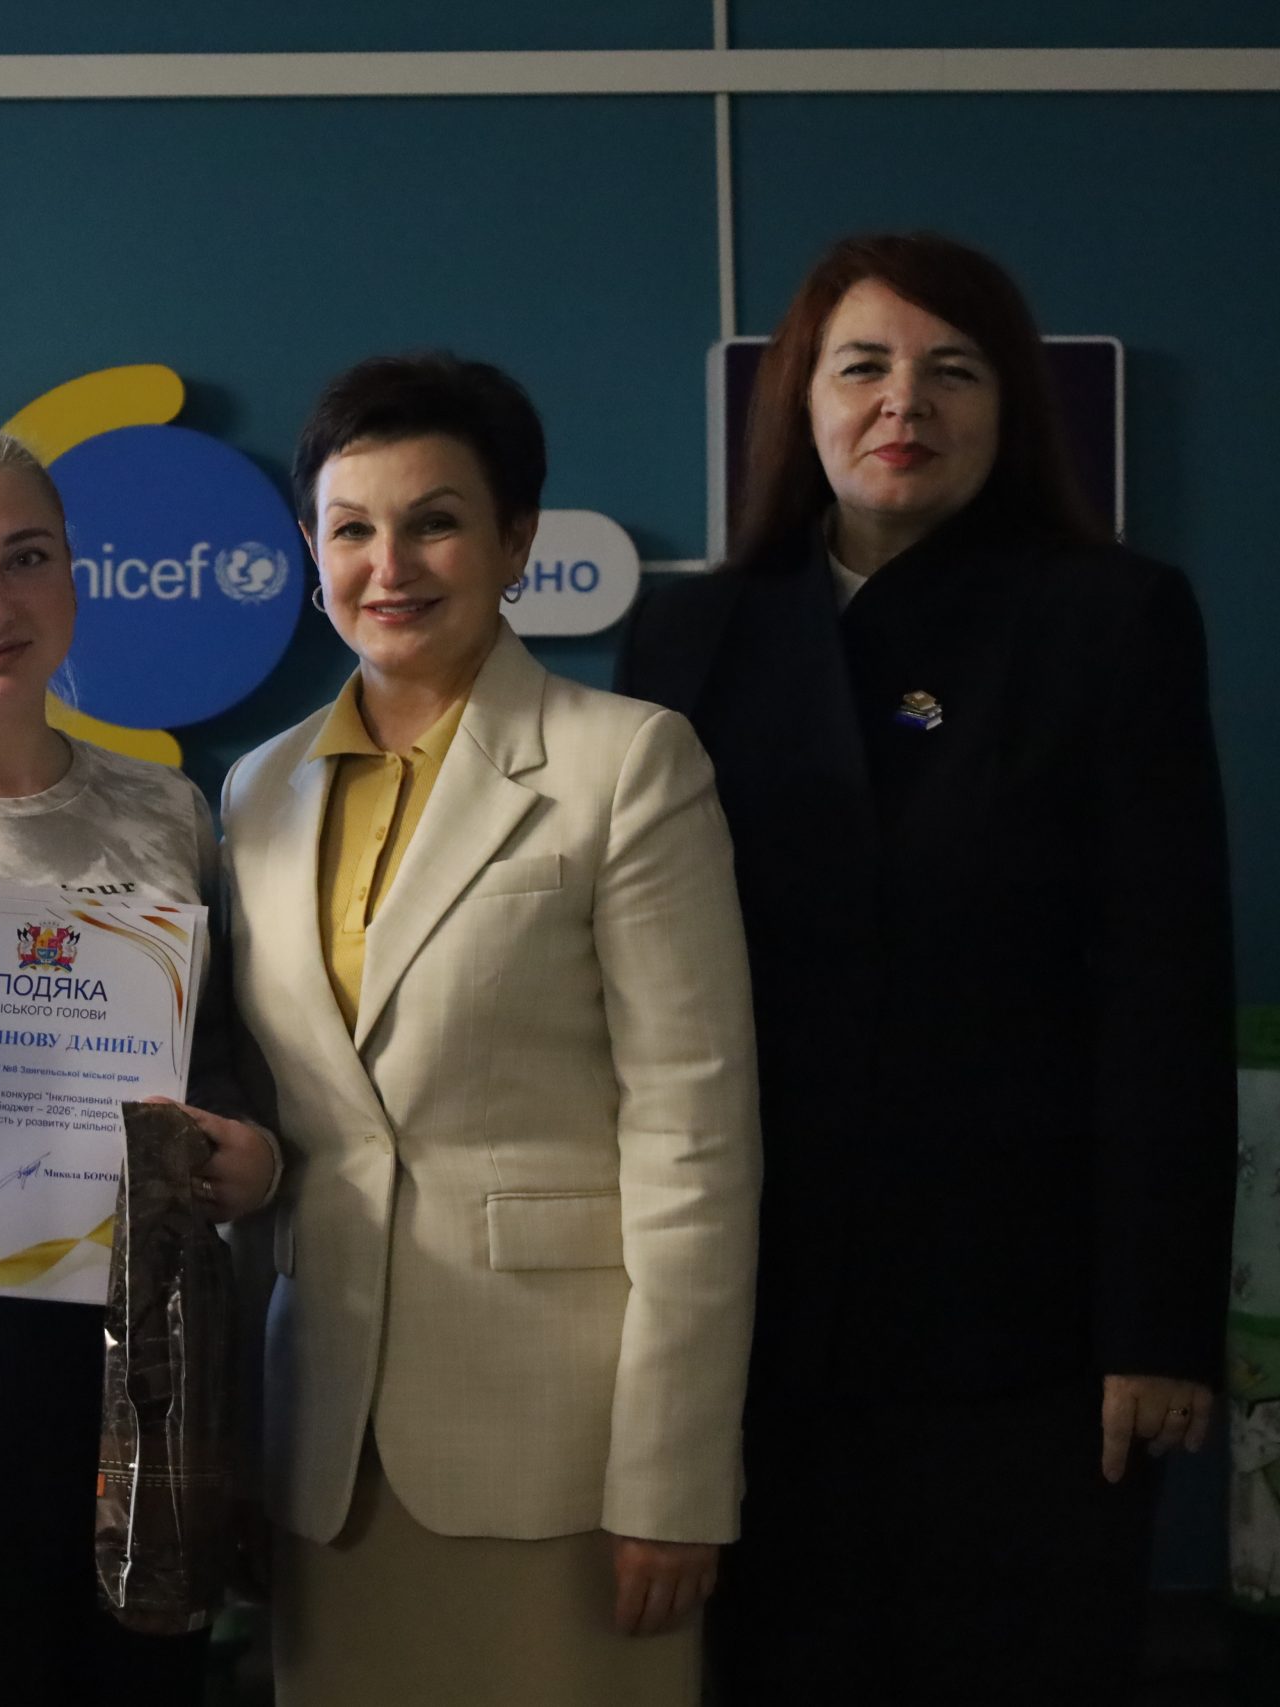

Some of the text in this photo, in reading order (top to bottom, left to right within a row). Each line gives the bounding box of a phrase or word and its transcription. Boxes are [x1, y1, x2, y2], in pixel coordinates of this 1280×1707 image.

[57, 1007, 107, 1021] ГОЛОВИ
[117, 1074, 139, 1082] ради
[1, 1091, 42, 1101] конкурсі
[25, 1118, 69, 1130] розвитку
[73, 1121, 116, 1133] шкільної
[44, 1169, 81, 1179] Микола
